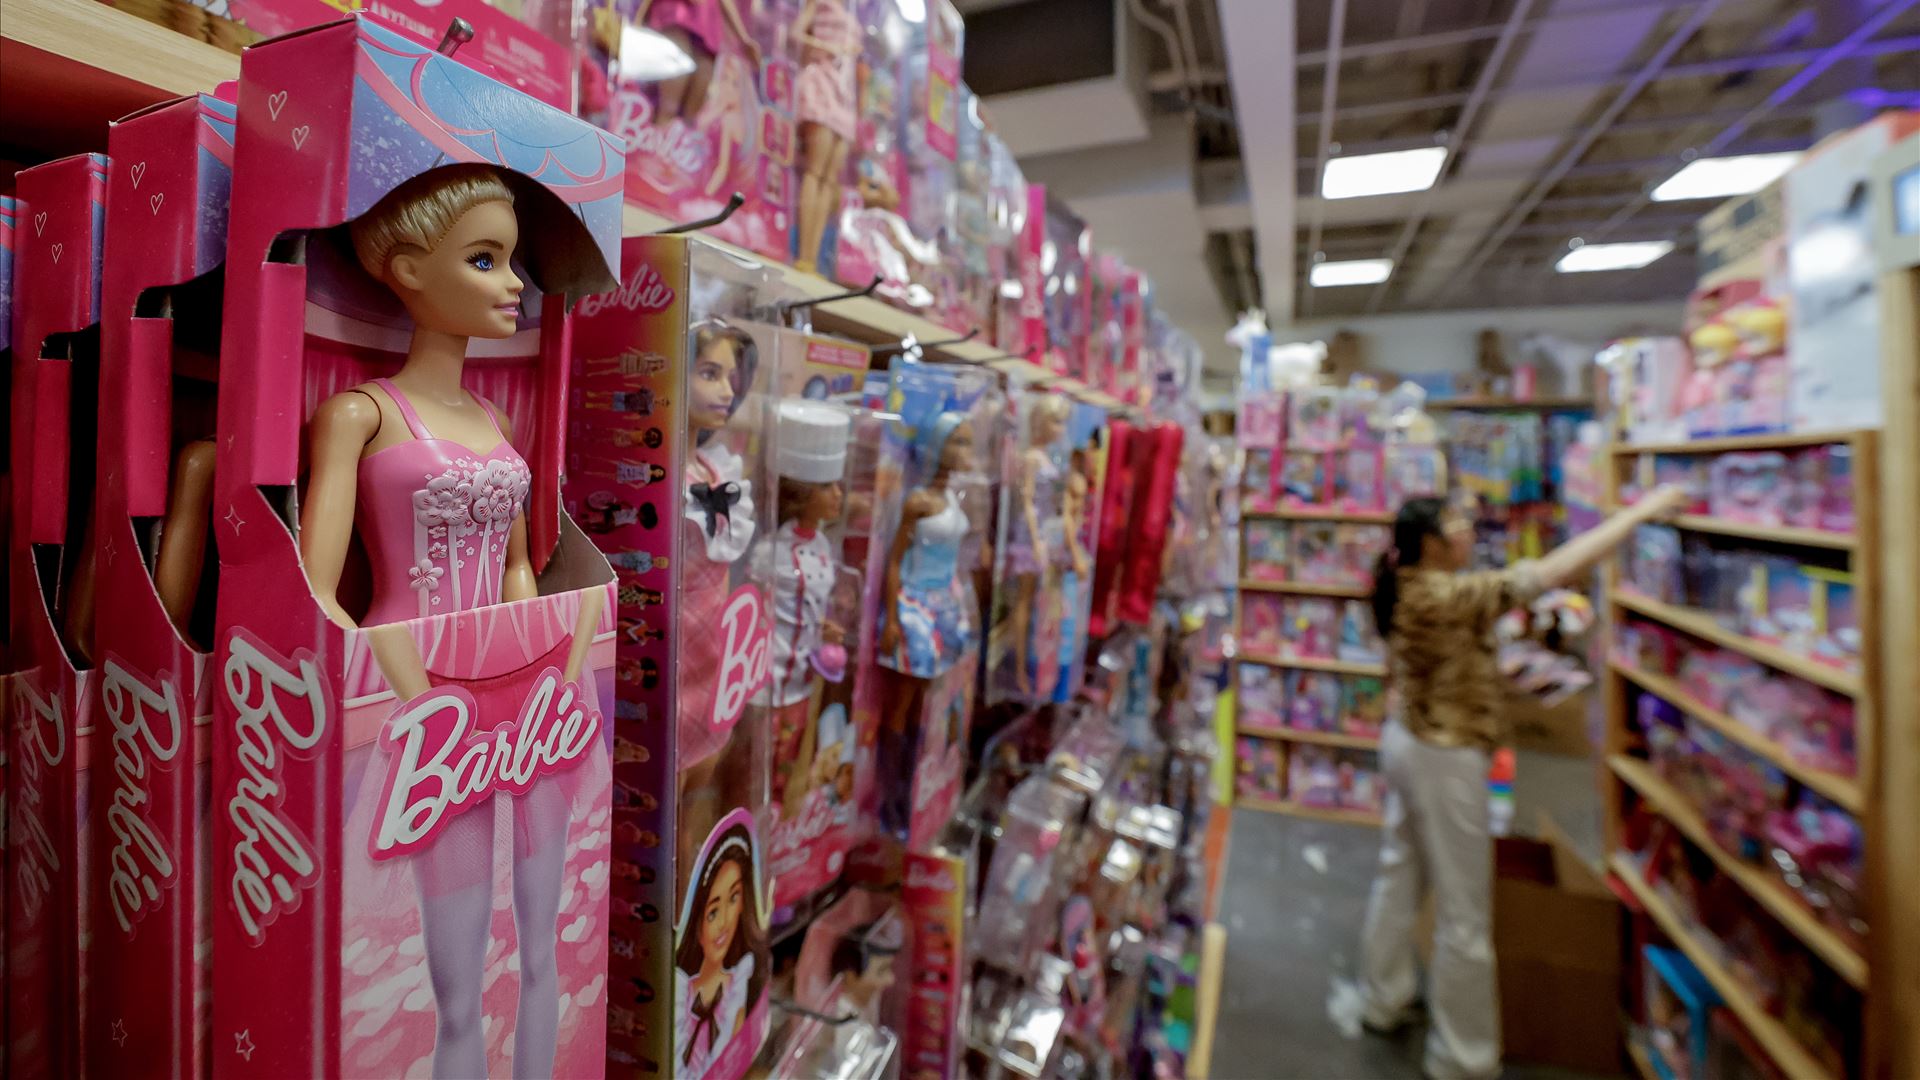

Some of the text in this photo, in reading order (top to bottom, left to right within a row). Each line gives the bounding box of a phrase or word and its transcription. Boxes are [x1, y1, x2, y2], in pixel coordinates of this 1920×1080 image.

[102, 659, 181, 932] Barbie
[225, 636, 326, 936] Barbie
[377, 675, 598, 850] Barbie
